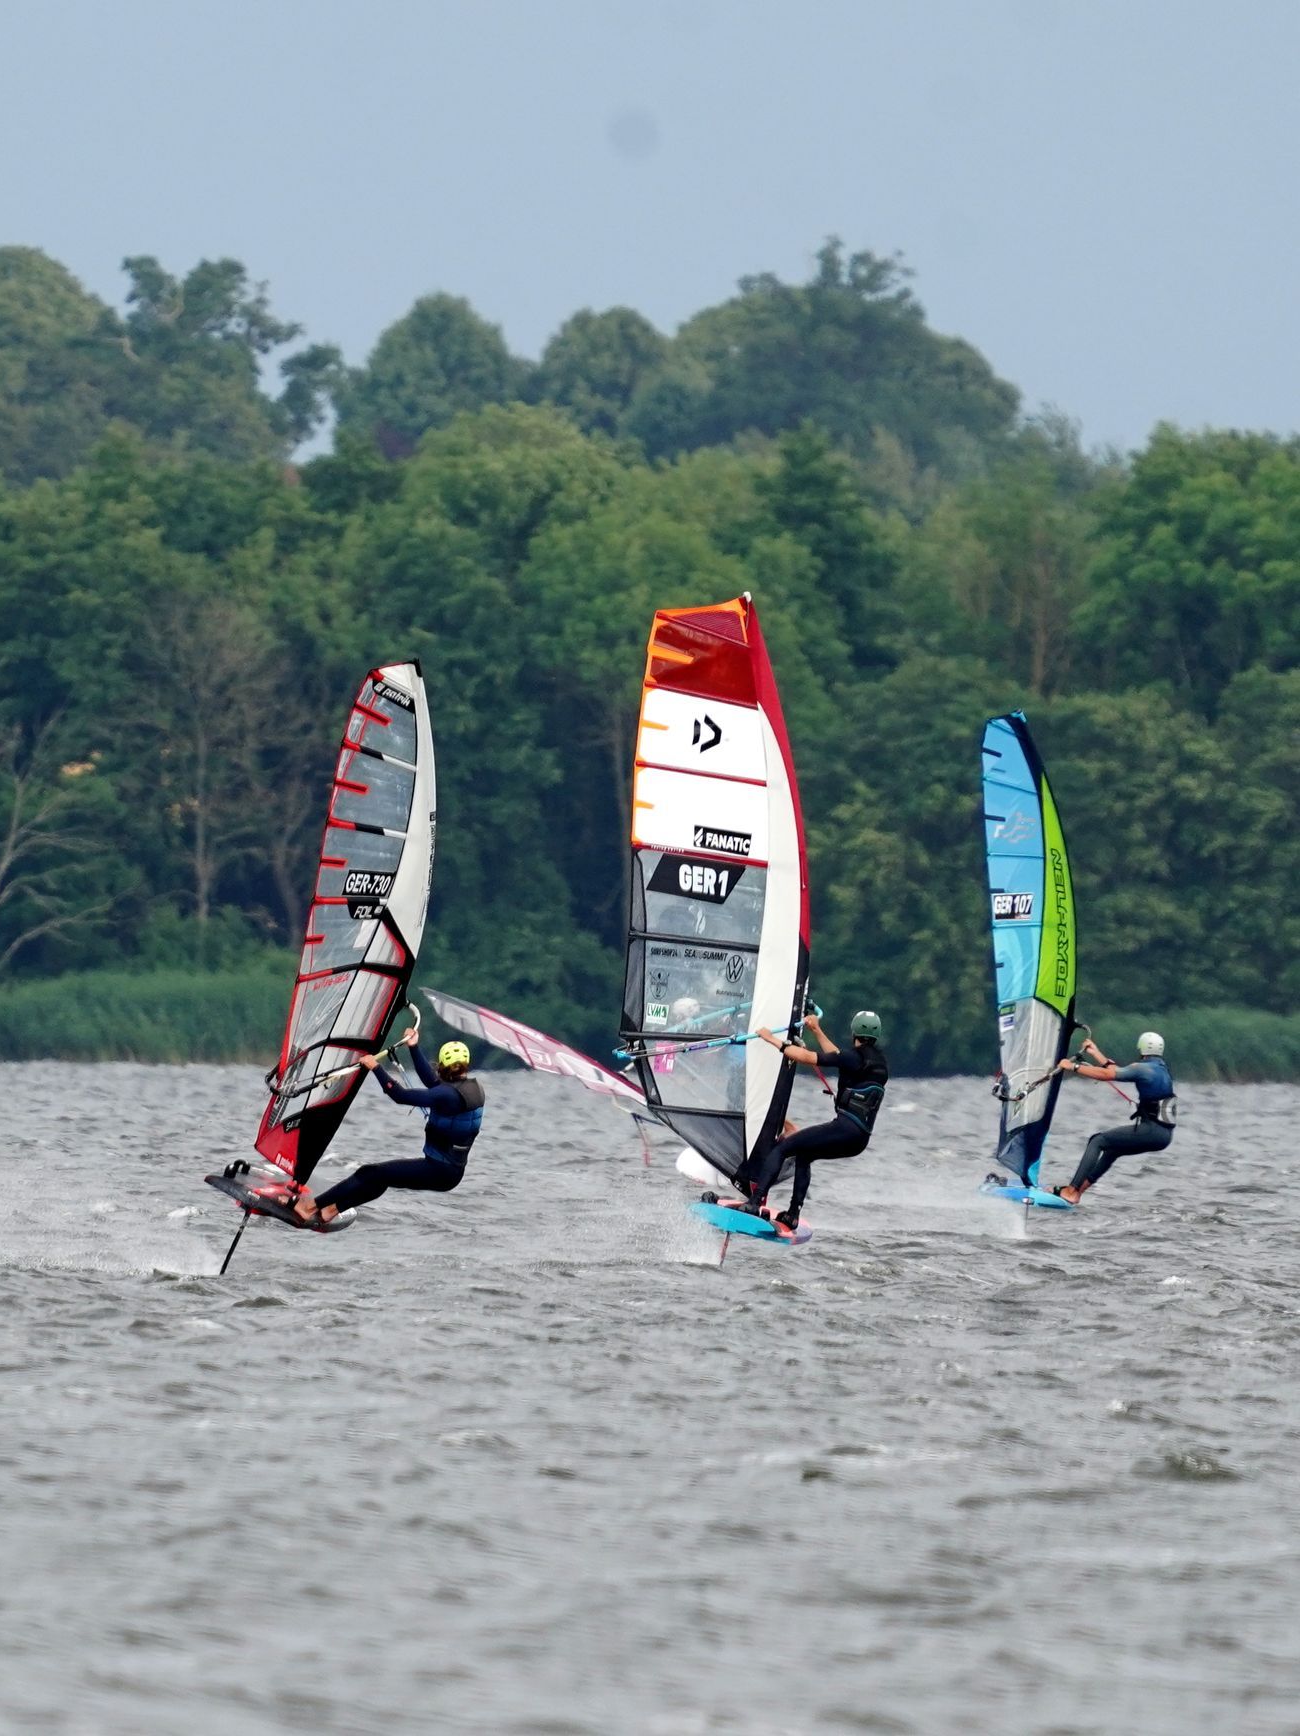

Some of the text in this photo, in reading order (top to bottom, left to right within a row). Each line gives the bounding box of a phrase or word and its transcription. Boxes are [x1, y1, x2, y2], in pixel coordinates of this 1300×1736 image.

[705, 832, 751, 853] FANATIC
[345, 873, 392, 895] GER-730
[678, 863, 729, 897] GER 1
[994, 895, 1034, 914] GER 107
[1050, 848, 1069, 998] NEILPRYDE
[684, 948, 728, 961] SEA SUMMIT
